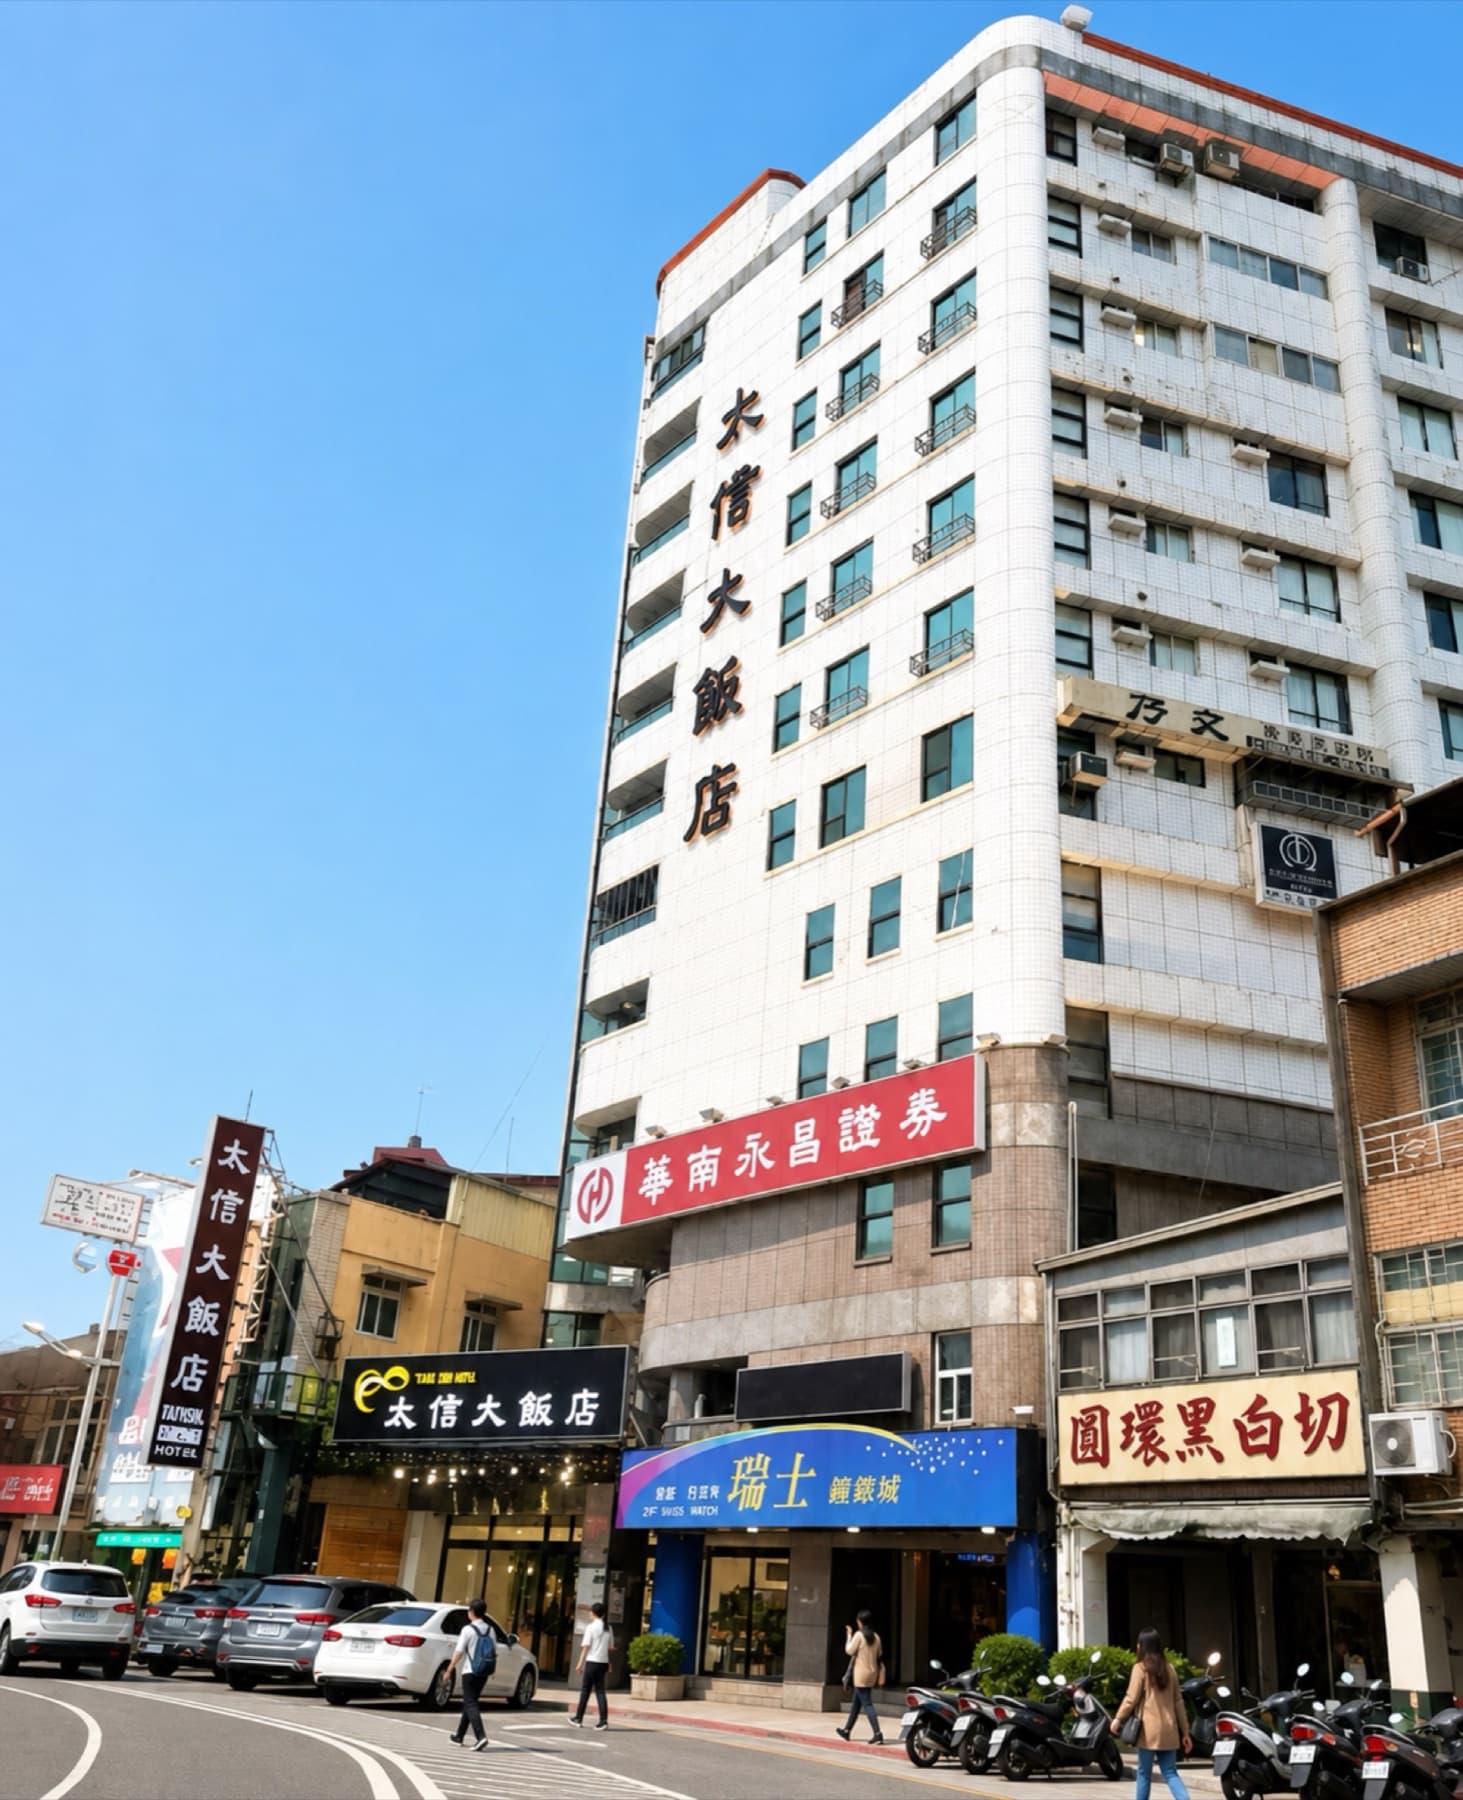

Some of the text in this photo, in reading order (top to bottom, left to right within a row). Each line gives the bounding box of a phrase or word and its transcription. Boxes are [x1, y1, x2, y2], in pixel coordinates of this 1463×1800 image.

[683, 387, 765, 842] 太信大飯店
[638, 1088, 947, 1205] 華南永昌證券
[170, 1138, 251, 1393] 太信大飯店
[383, 1387, 600, 1430] 太信大飯店
[1071, 1392, 1350, 1468] 圓環黑白切
[154, 1444, 198, 1459] HOTEL
[727, 1452, 817, 1511] 瑞士
